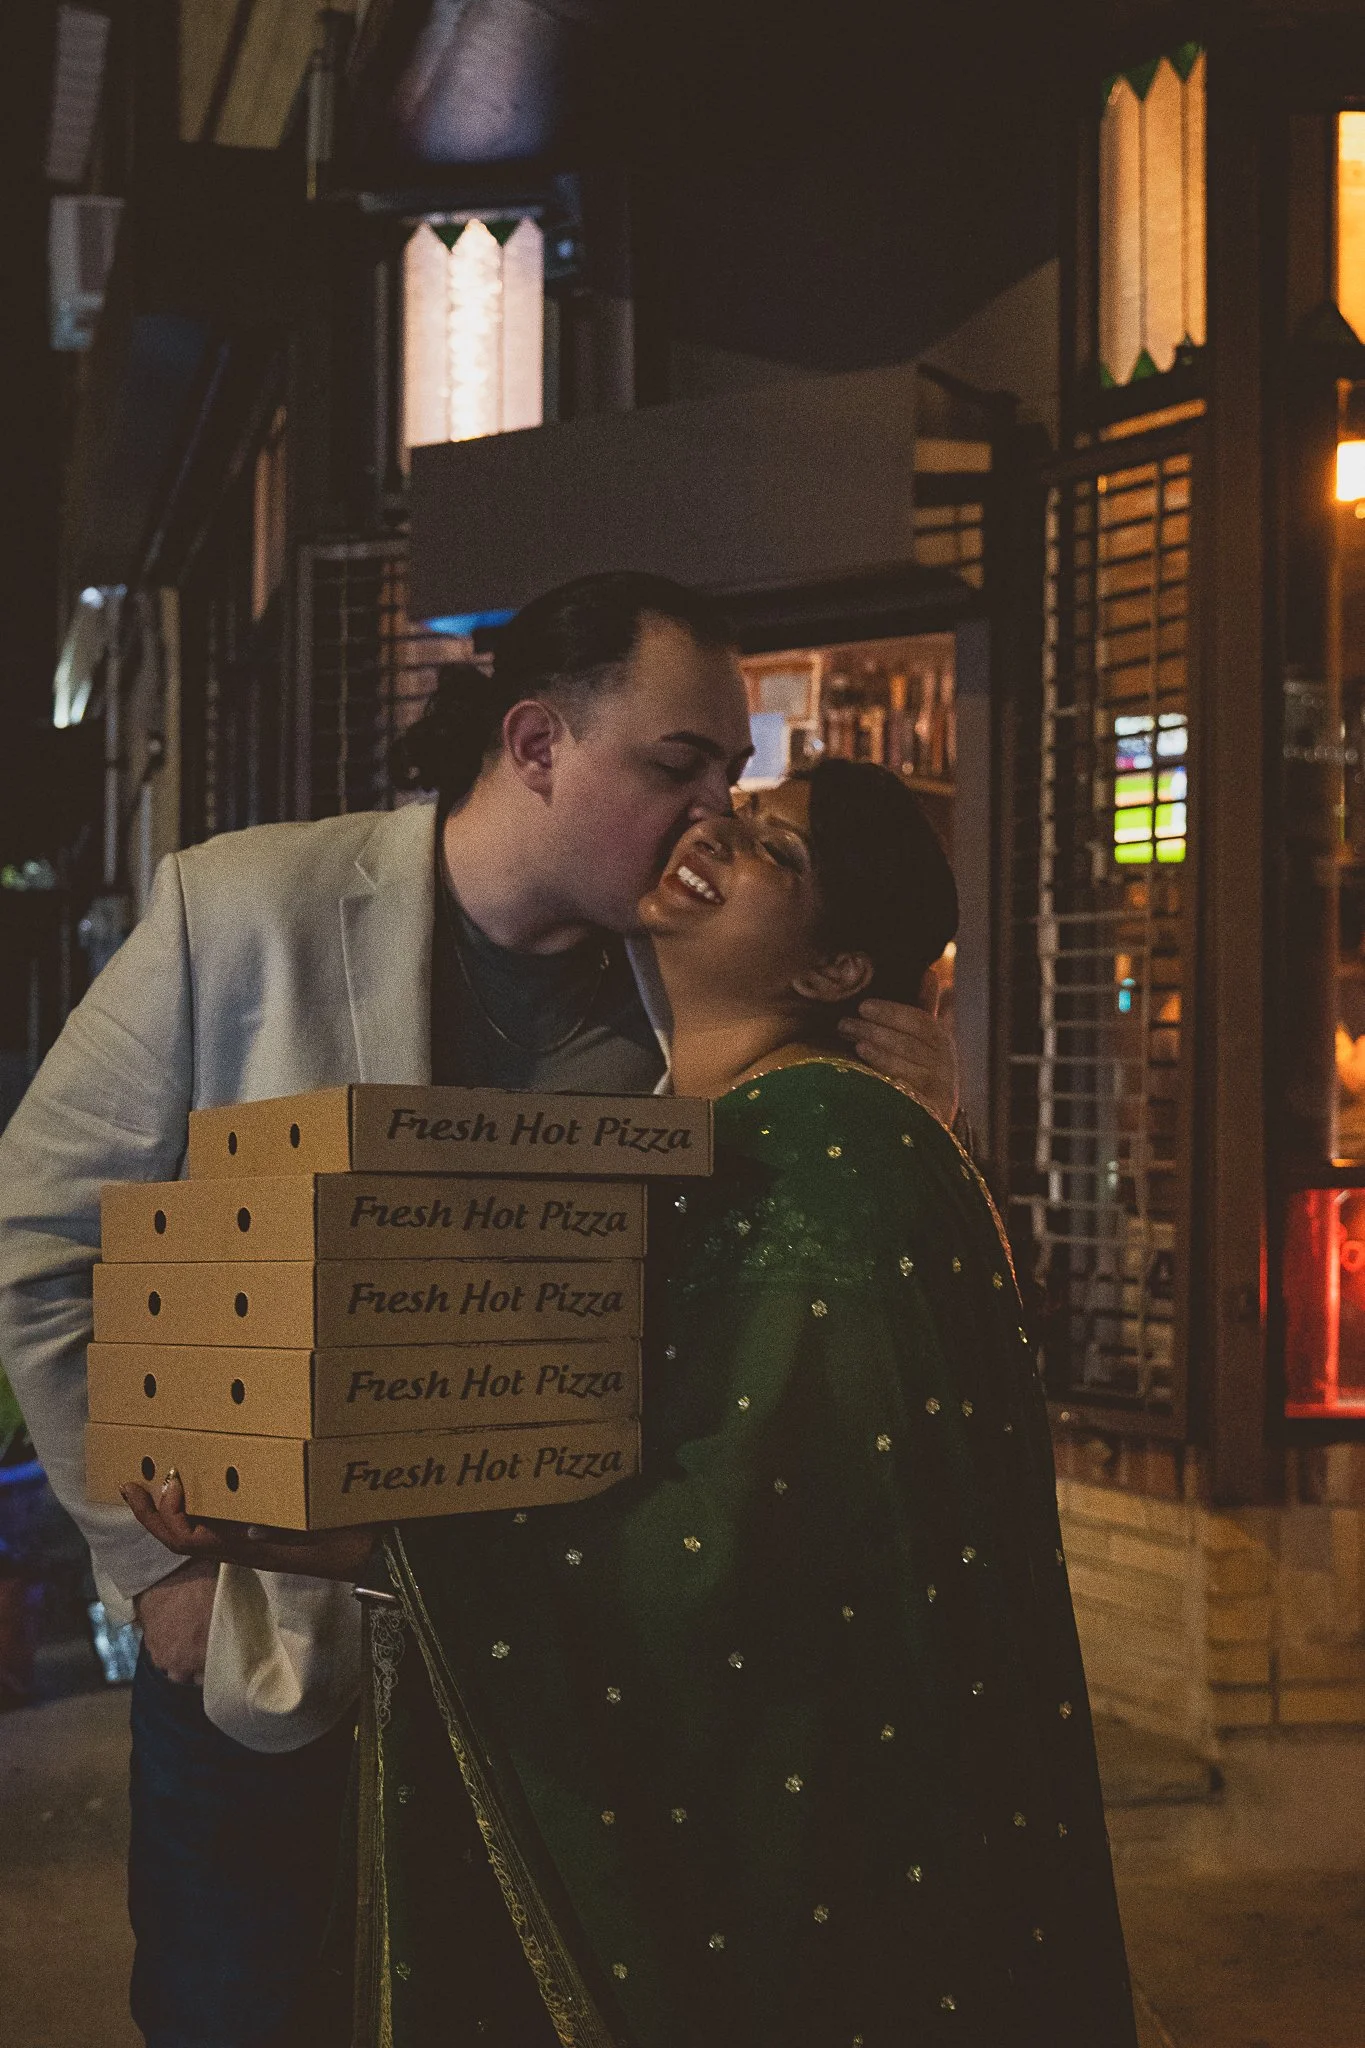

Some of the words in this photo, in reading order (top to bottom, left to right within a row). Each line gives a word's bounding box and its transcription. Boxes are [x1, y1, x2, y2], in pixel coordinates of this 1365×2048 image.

[387, 1109, 497, 1142] Fresh
[510, 1112, 581, 1145] Hot
[594, 1117, 691, 1153] Pizza
[350, 1196, 451, 1227] Fresh
[463, 1197, 528, 1230] Hot
[540, 1201, 626, 1236] Pizza
[348, 1283, 449, 1314] Fresh
[460, 1280, 524, 1314] Hot
[535, 1283, 622, 1317] Pizza
[347, 1371, 450, 1402] Fresh
[460, 1365, 524, 1400] Hot
[536, 1365, 621, 1398] Pizza
[342, 1458, 445, 1493] Fresh
[457, 1449, 522, 1486] Hot
[534, 1447, 621, 1479] Pizza
